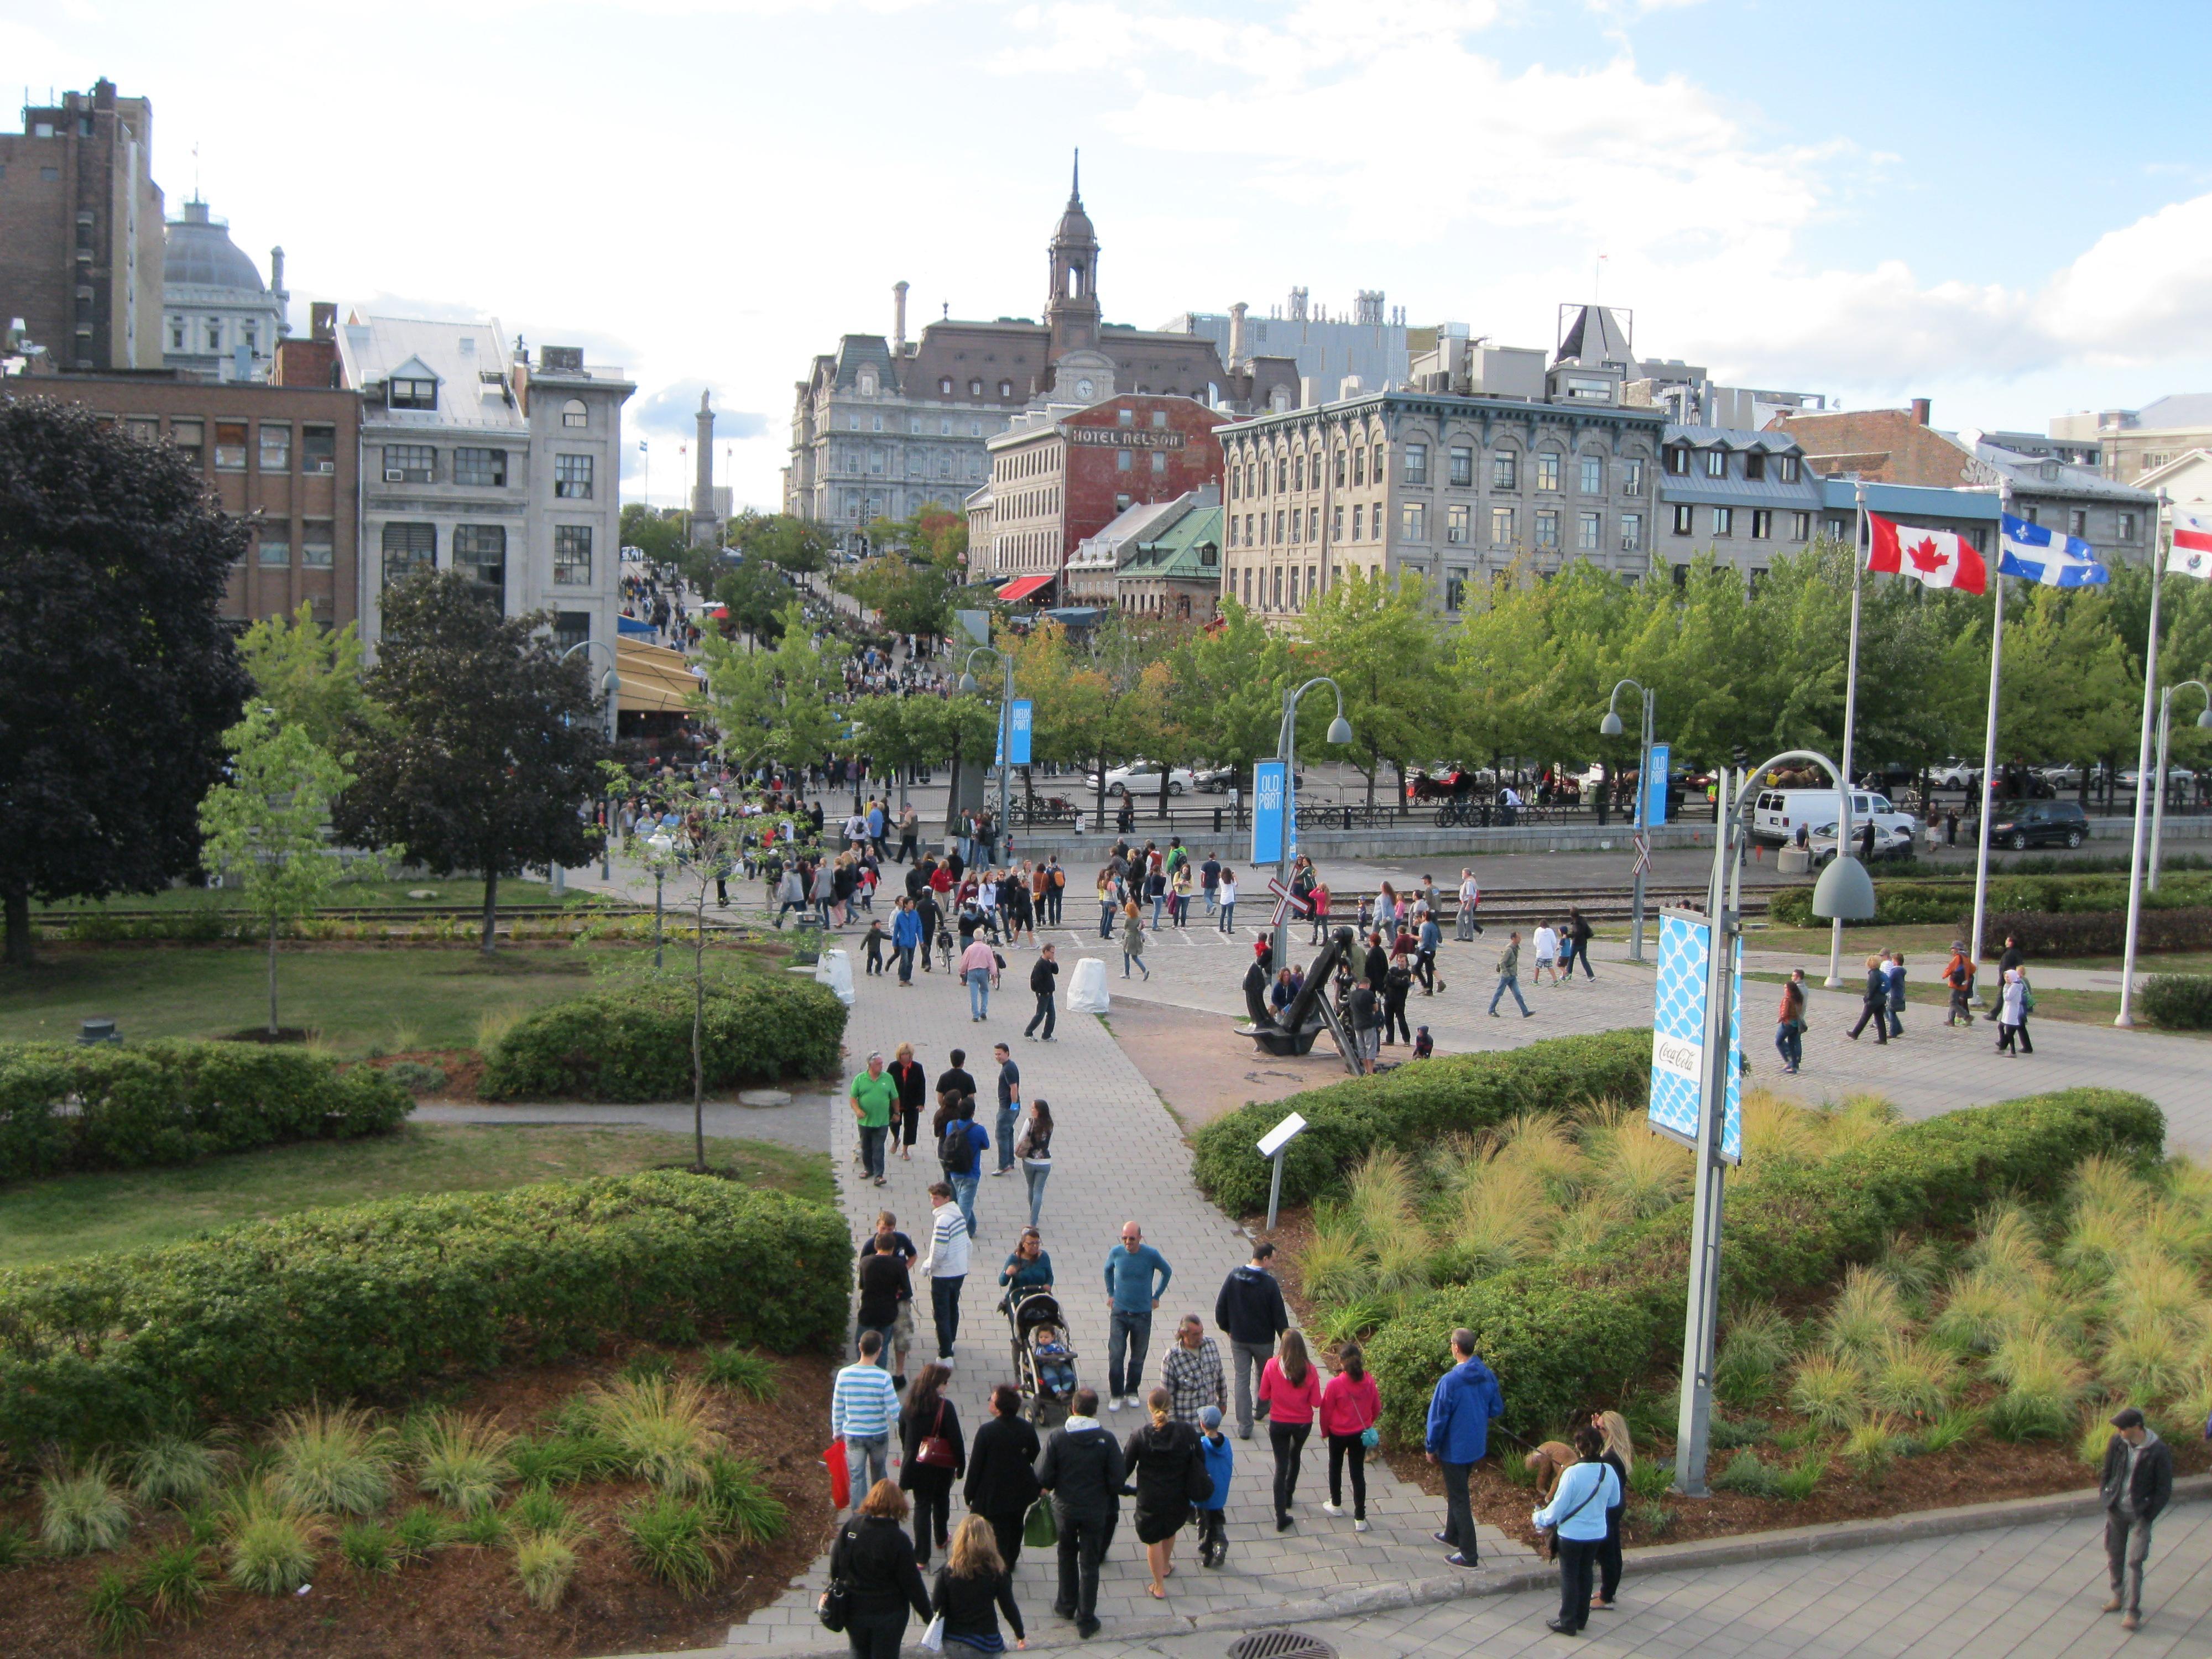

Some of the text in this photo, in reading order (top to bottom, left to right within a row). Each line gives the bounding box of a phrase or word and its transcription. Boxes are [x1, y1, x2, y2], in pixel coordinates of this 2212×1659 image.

[1073, 429, 1118, 443] HOTEL
[1013, 719, 1029, 731] PORT
[1653, 756, 1665, 769] OLD
[1261, 775, 1279, 792] OLD
[1651, 770, 1666, 784] PORT
[1258, 792, 1281, 810] PORT
